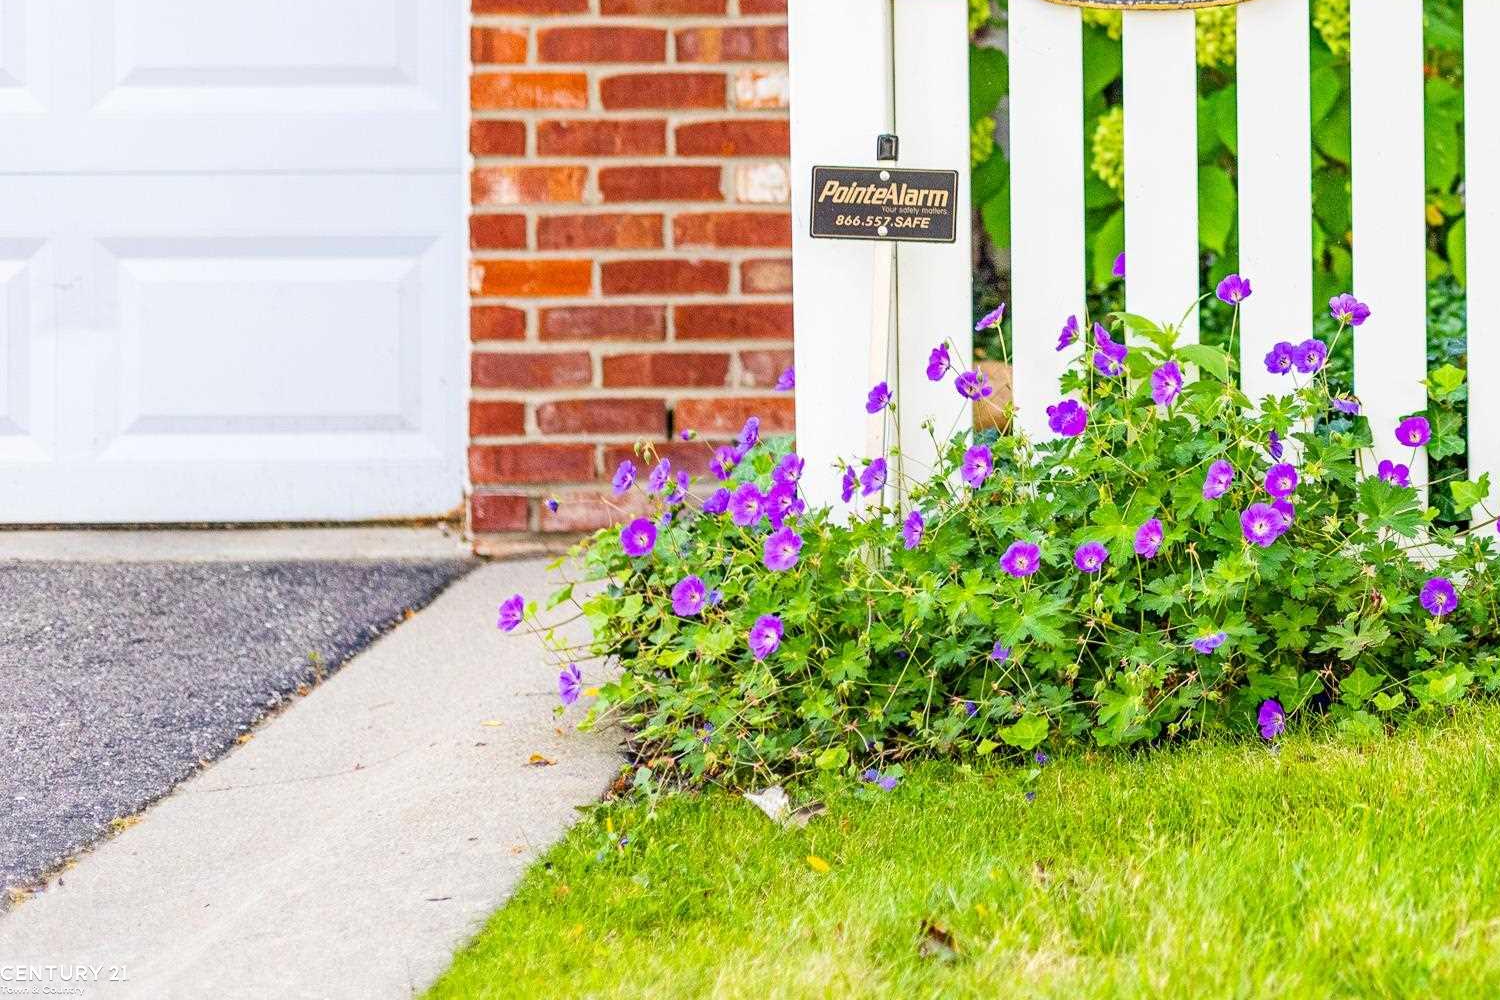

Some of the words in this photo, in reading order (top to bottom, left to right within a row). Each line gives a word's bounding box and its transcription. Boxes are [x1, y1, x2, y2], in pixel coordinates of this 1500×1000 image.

[818, 180, 949, 208] PointeAlarm
[882, 205, 897, 214] Your
[899, 207, 920, 216] safety
[835, 214, 931, 230] 866.557.SAFE
